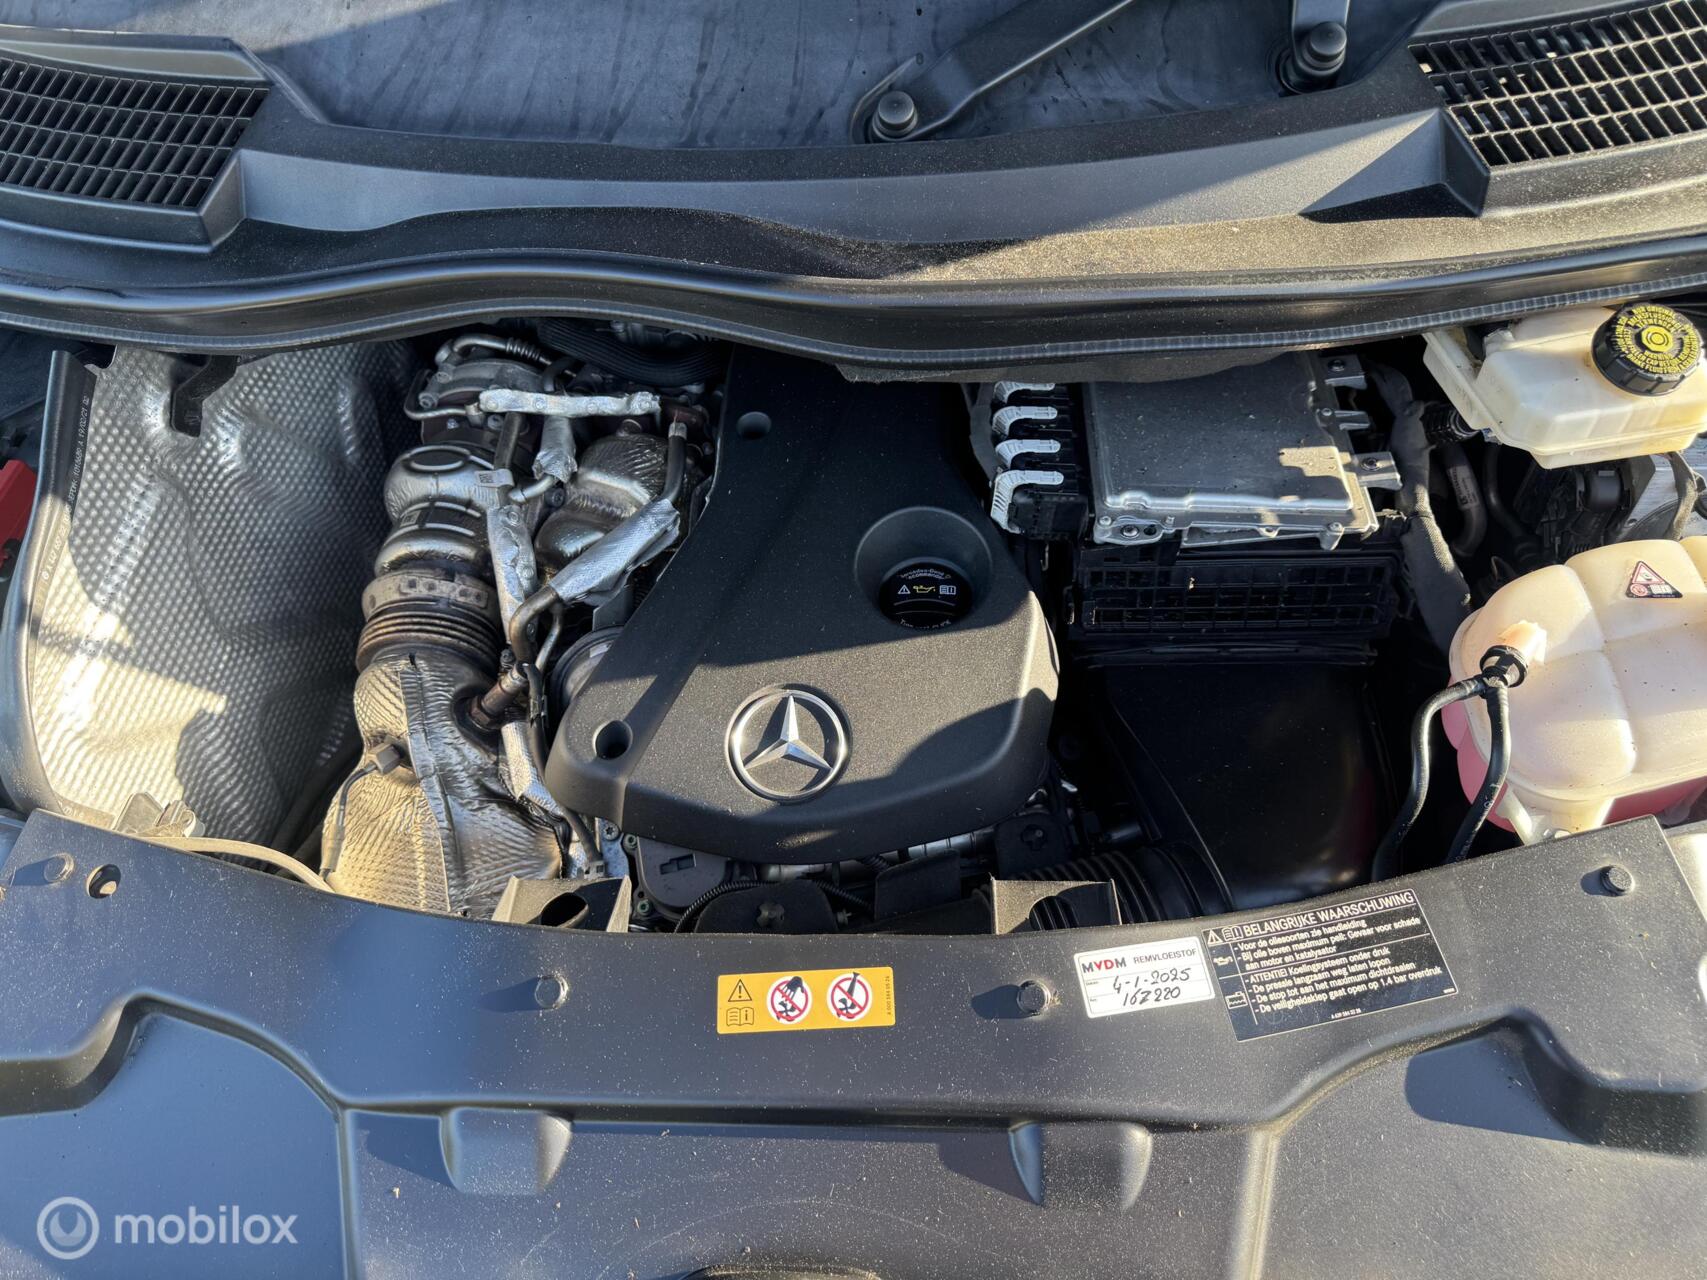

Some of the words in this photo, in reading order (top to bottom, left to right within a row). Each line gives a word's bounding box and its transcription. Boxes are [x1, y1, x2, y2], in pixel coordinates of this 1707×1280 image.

[1242, 912, 1317, 936] BELANGRIJKE
[1316, 892, 1414, 921] WAARSCHUWING
[1237, 941, 1256, 951] Voor
[1257, 938, 1267, 947] de
[1309, 928, 1322, 937] zie
[1321, 919, 1367, 934] handleiding
[1241, 950, 1253, 961] Bij
[1252, 948, 1267, 958] olie
[1267, 945, 1291, 955] boven
[1291, 937, 1329, 951] maximum
[1346, 927, 1374, 939] Gevaar
[1374, 923, 1392, 932] voor
[1393, 916, 1420, 929] schade
[1082, 957, 1127, 973] MVDM
[1133, 948, 1197, 964] REMVLOEISTOF
[1245, 961, 1259, 970] aan
[1259, 956, 1282, 967] motor
[1283, 954, 1294, 962] en
[1294, 945, 1336, 960] katalysator
[1348, 951, 1370, 962] onder
[1372, 946, 1390, 957] druk
[1252, 984, 1264, 993] De
[1292, 970, 1330, 985] langzaam
[1330, 967, 1348, 976] weg
[1346, 962, 1368, 972] laten
[1367, 957, 1391, 968] lopen
[1255, 994, 1268, 1003] De
[1268, 991, 1286, 1000] stop
[1286, 987, 1299, 996] tot
[1299, 985, 1314, 993] aan
[1313, 980, 1329, 990] het
[1328, 973, 1367, 987] maximum
[1368, 962, 1416, 978] dichtdraaien
[1258, 1004, 1271, 1013] De
[1328, 987, 1347, 999] gaat
[1346, 983, 1367, 995] open
[1367, 981, 1378, 990] op
[1379, 976, 1393, 986] 1.4
[1392, 974, 1406, 983] bar
[1407, 965, 1442, 980] overdruk
